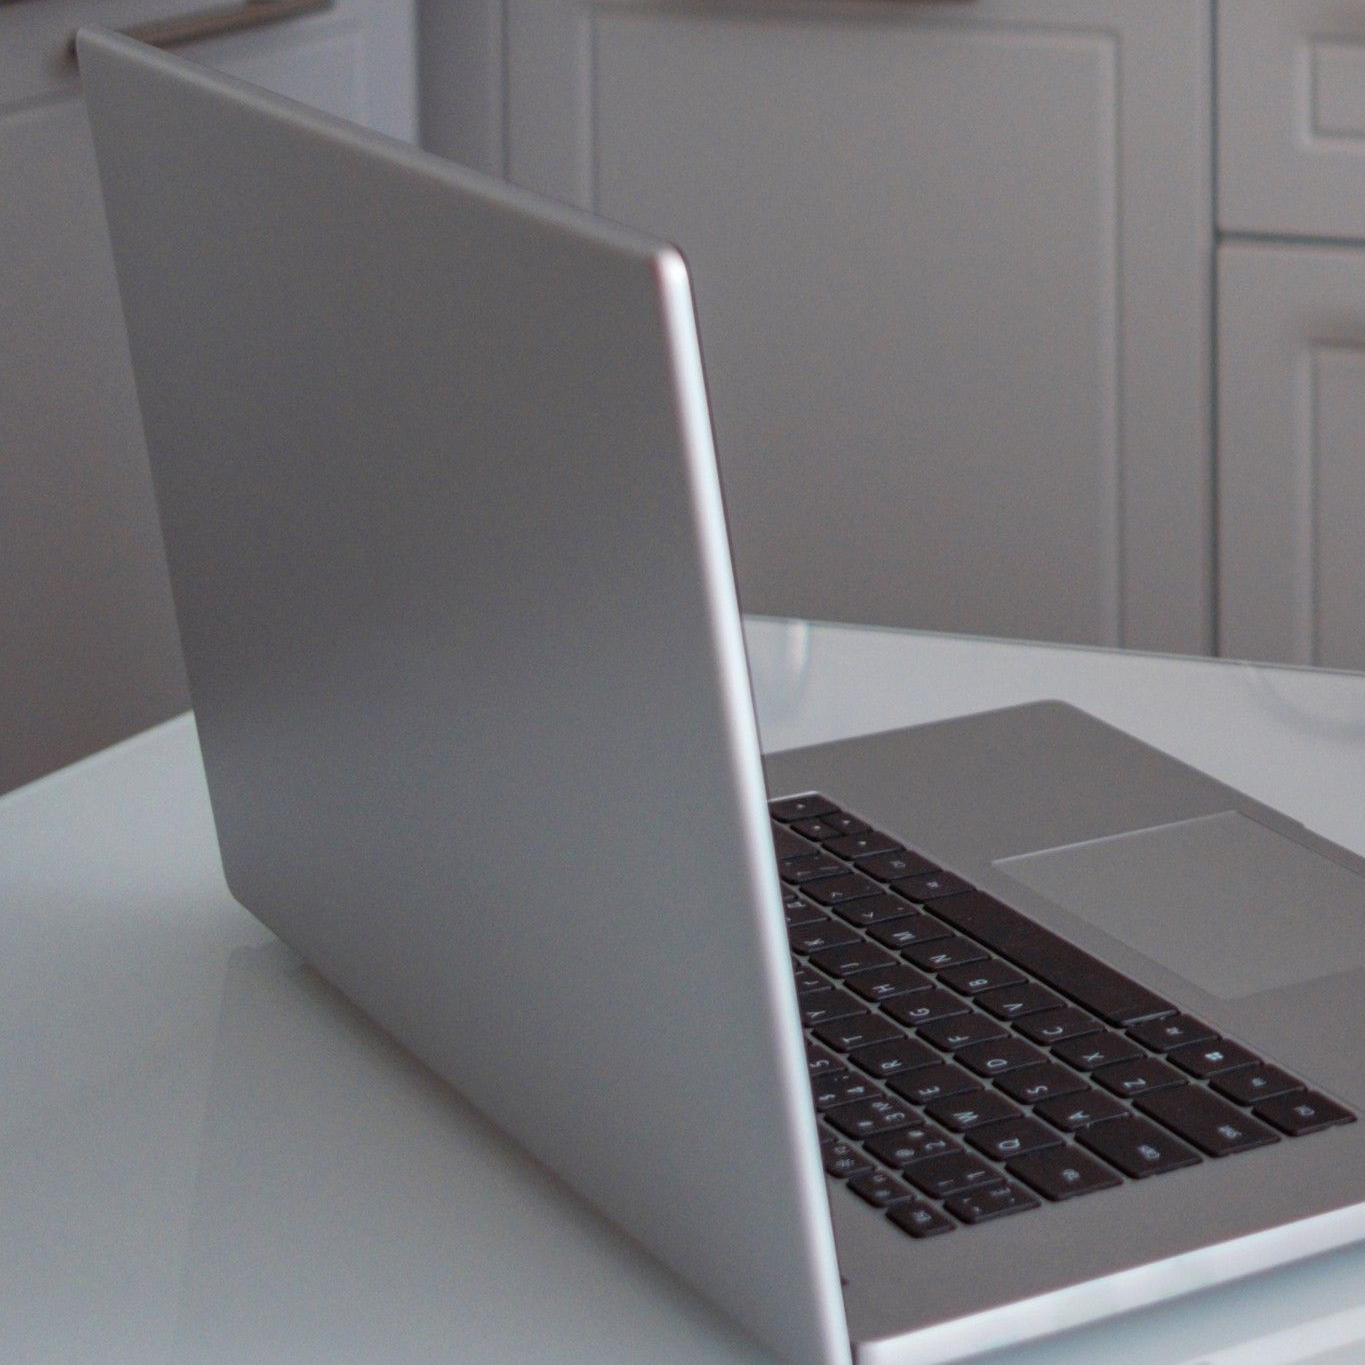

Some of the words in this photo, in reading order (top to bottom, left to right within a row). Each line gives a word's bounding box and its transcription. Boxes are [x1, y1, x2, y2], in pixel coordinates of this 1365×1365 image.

[892, 931, 916, 941] M
[928, 954, 952, 965] N
[968, 978, 989, 987] B
[873, 984, 896, 994] H
[1003, 1002, 1024, 1012] V
[909, 1007, 930, 1018] G
[1041, 1026, 1063, 1036] C
[842, 1035, 863, 1043] T
[948, 1035, 970, 1043] F
[1082, 1052, 1104, 1062] X
[881, 1059, 902, 1070] R
[986, 1058, 1008, 1068] D
[1123, 1078, 1147, 1088] Z
[917, 1085, 940, 1096] E
[1027, 1086, 1048, 1096] S
[953, 1110, 979, 1123] W
[1067, 1110, 1090, 1121] A
[998, 1137, 1021, 1150] Q
